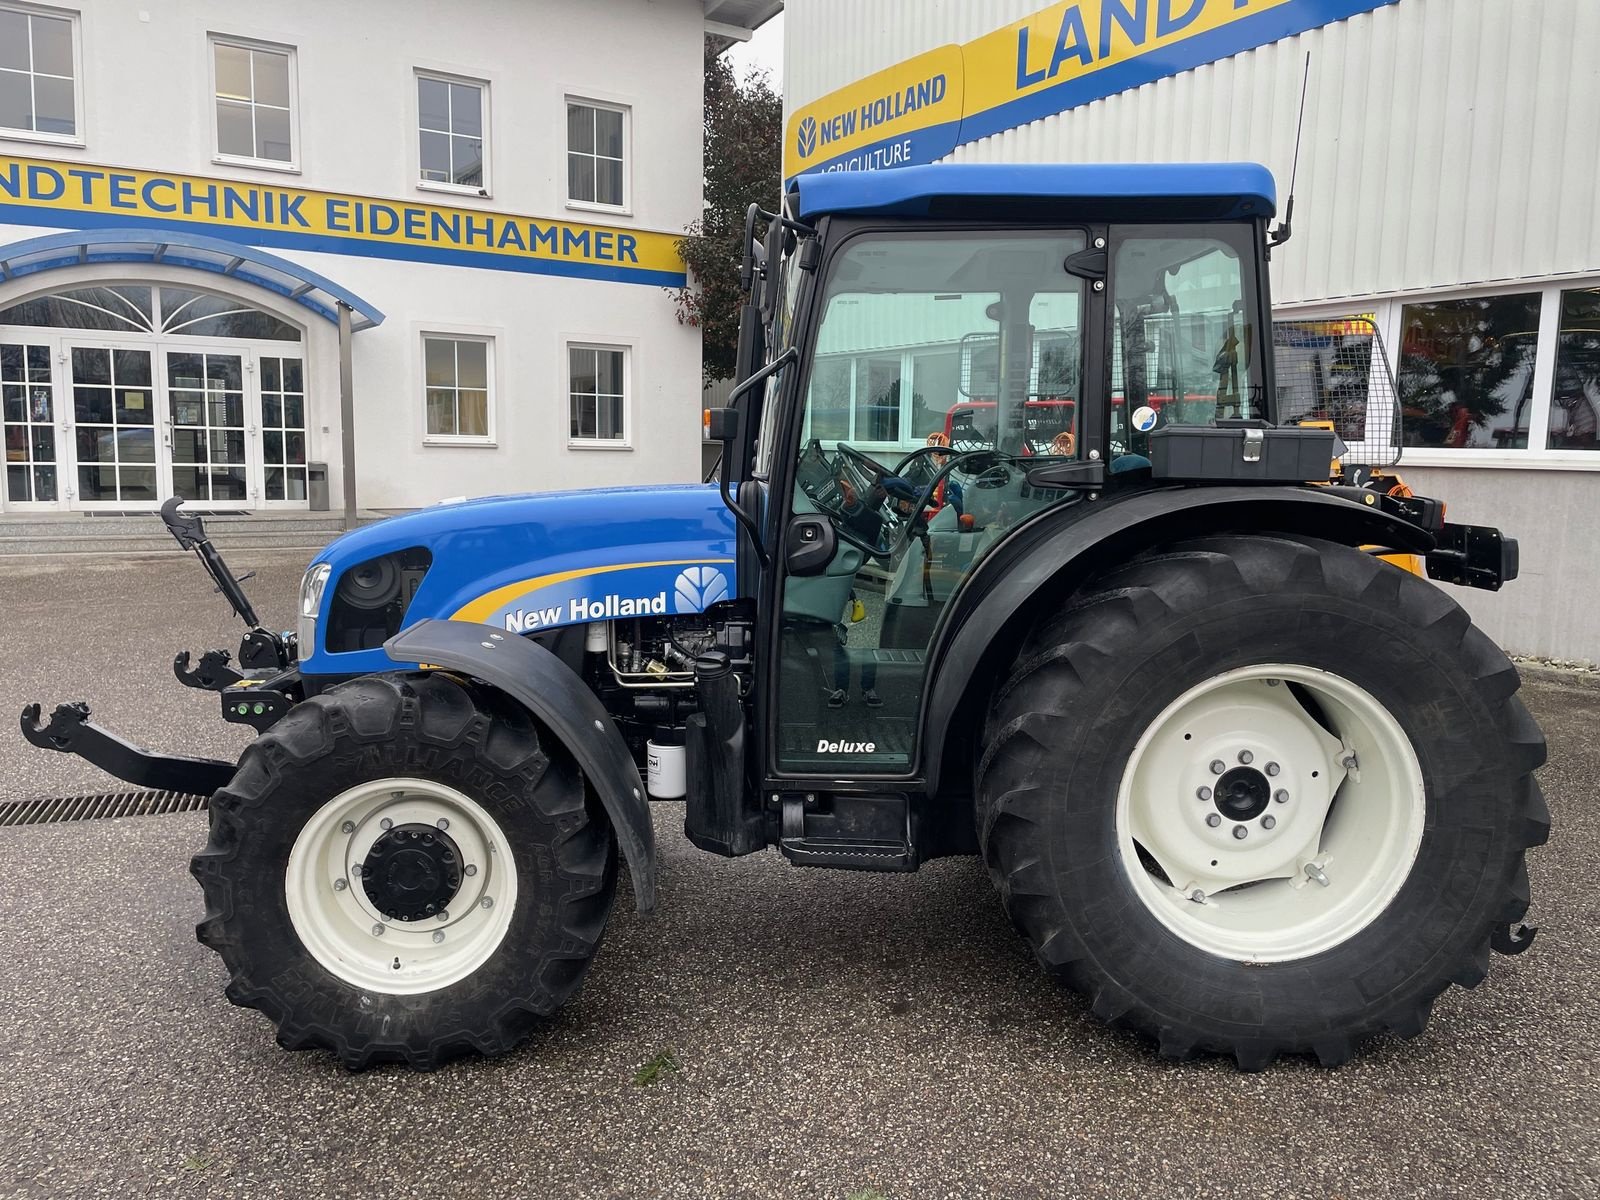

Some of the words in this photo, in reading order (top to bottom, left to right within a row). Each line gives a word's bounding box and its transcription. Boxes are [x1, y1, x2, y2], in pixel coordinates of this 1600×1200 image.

[1016, 0, 1249, 90] LAN
[820, 108, 857, 146] NEW
[860, 73, 946, 131] HOLLAND
[820, 139, 911, 174] ICULTURE
[325, 198, 639, 263] EIDENHAMMER
[505, 605, 562, 633] New
[569, 591, 667, 621] Holland
[816, 739, 876, 753] Deluxe
